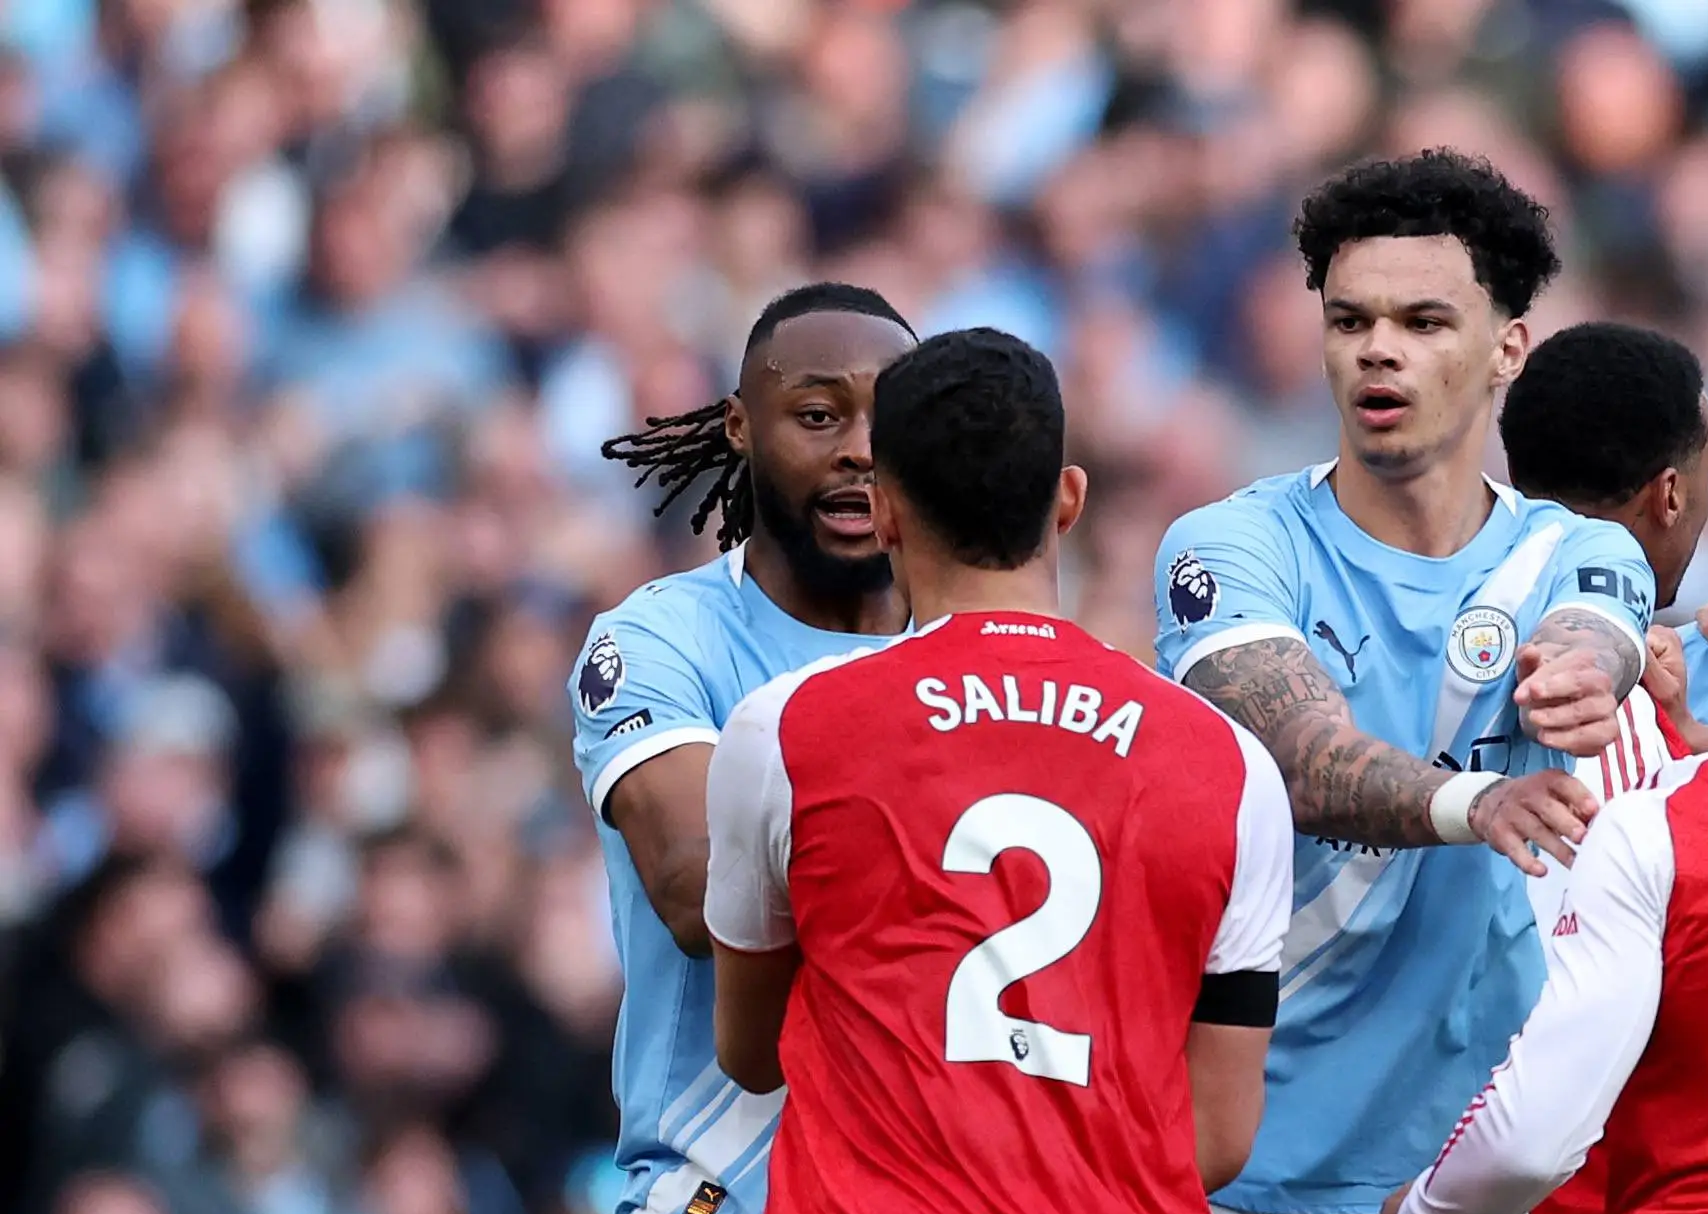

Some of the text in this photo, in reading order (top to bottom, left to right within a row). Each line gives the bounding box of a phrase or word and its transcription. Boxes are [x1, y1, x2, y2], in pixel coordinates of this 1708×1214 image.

[980, 620, 1057, 640] Arsenal
[1452, 611, 1511, 638] MANCHESTER
[1476, 669, 1497, 679] CITY
[916, 673, 1145, 758] SALIBA
[942, 793, 1102, 1087] 2
